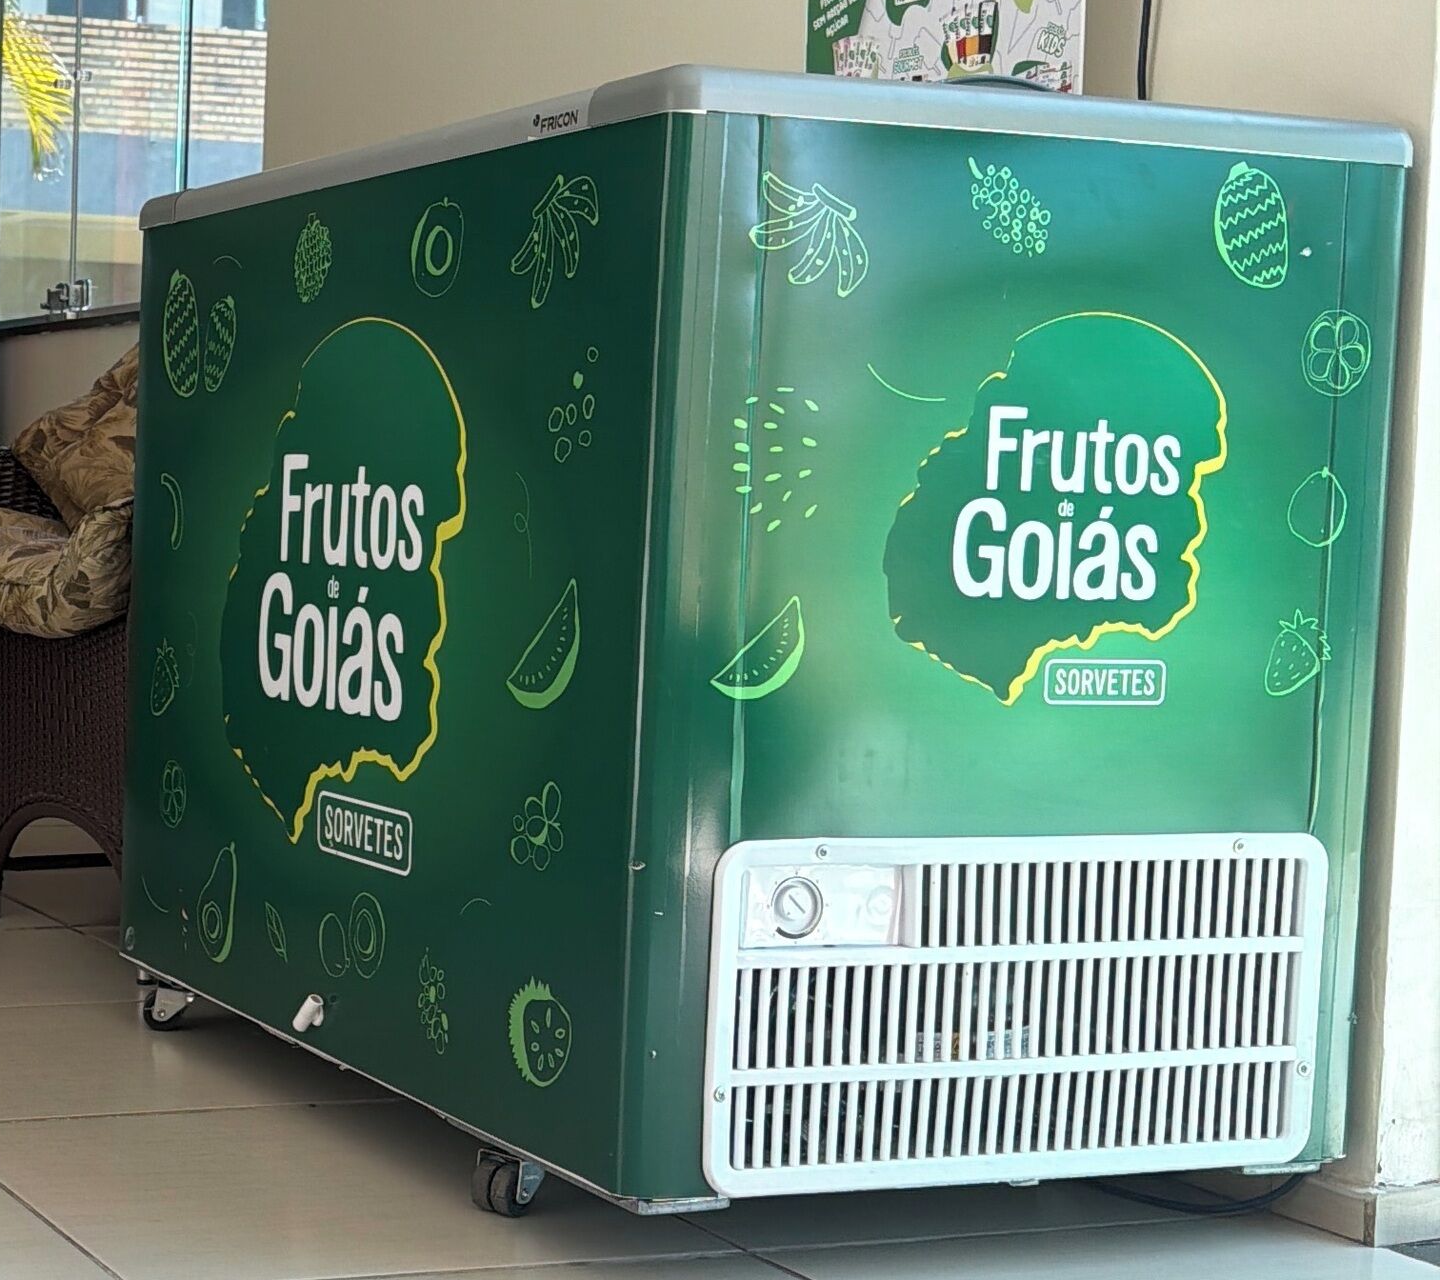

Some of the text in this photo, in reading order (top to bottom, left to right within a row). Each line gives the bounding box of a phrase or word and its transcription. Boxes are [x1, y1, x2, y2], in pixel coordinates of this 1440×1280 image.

[1037, 29, 1067, 58] KIDS
[540, 109, 579, 133] FRICON
[986, 406, 1181, 496] Frutos
[280, 453, 425, 571] Frutos
[1058, 499, 1074, 517] de
[952, 497, 1158, 601] Goiás
[327, 575, 340, 599] de
[258, 572, 404, 721] Goiás
[1054, 668, 1156, 696] SORVETES
[324, 804, 404, 861] SORVETES
